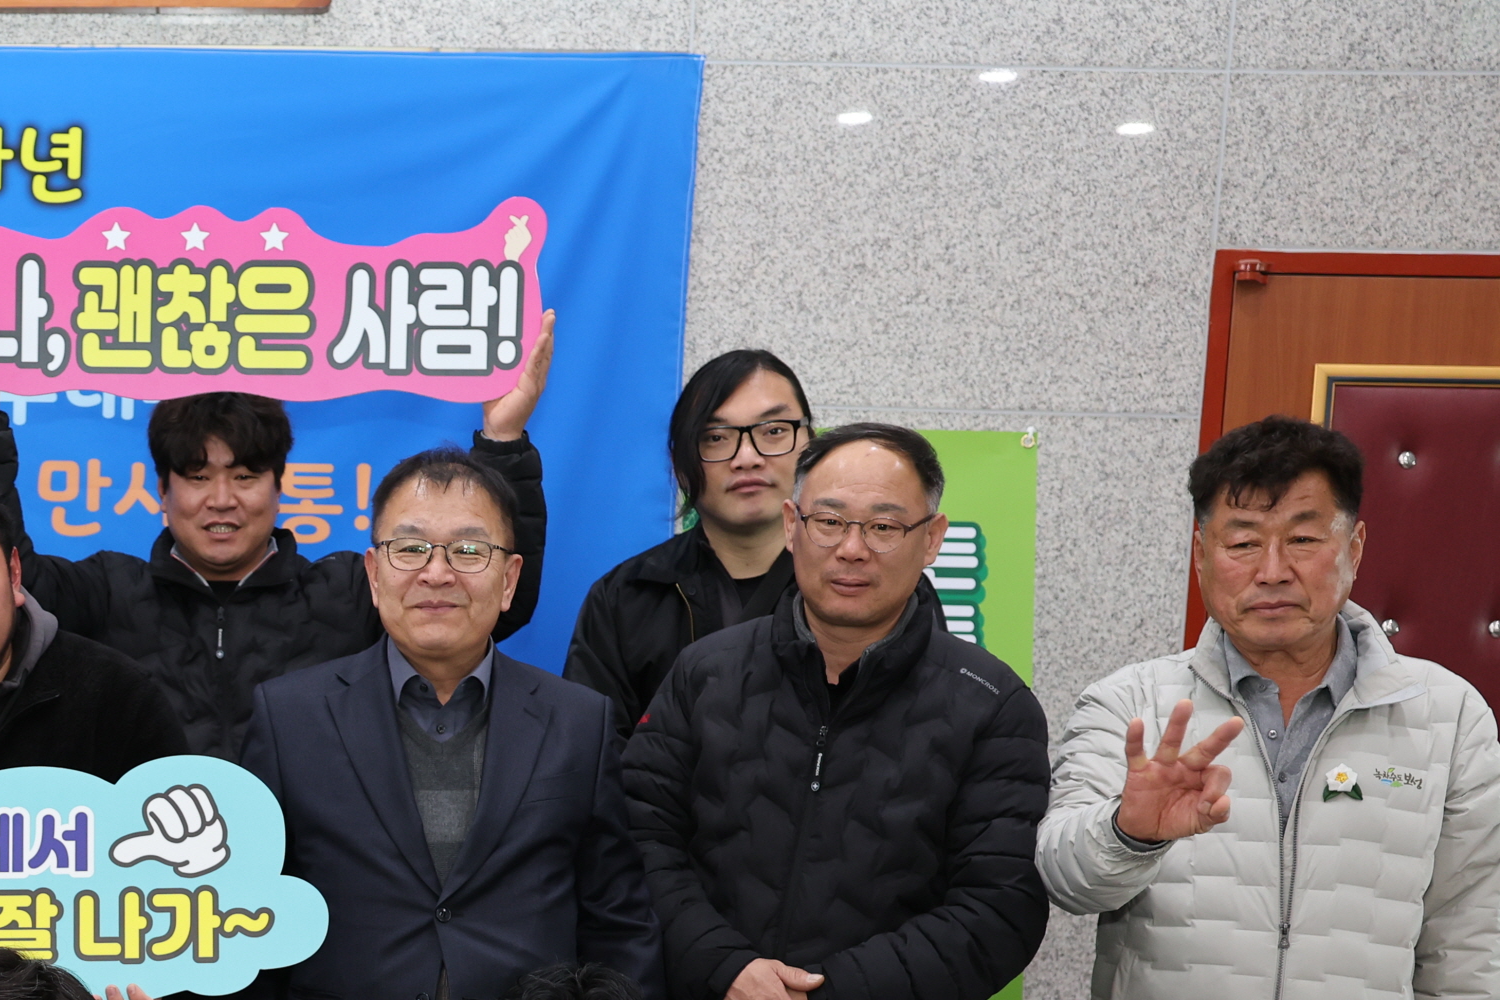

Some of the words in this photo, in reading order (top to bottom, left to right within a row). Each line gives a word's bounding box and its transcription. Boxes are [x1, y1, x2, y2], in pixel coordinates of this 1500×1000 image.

[327, 258, 525, 376] 사람!
[966, 670, 1000, 695] MONCROSS
[1404, 773, 1423, 789] 보성
[78, 887, 275, 963] 나가~
